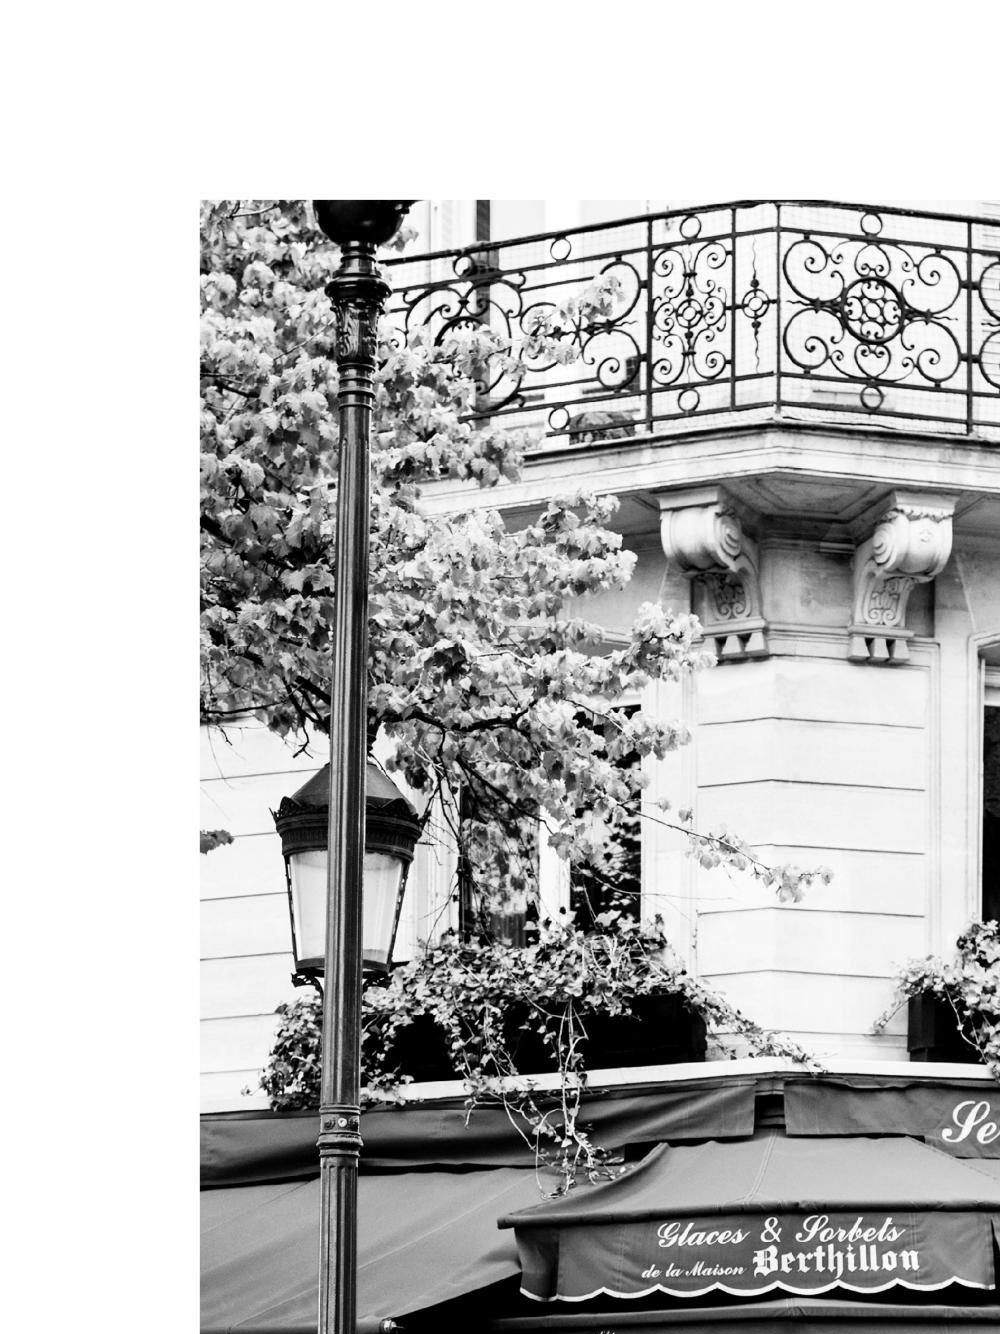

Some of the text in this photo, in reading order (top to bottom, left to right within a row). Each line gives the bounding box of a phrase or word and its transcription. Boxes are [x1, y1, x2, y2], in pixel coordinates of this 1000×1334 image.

[658, 1214, 906, 1248] Glaces & Sorbets
[641, 1244, 921, 1280] de la Maison Berthillon
